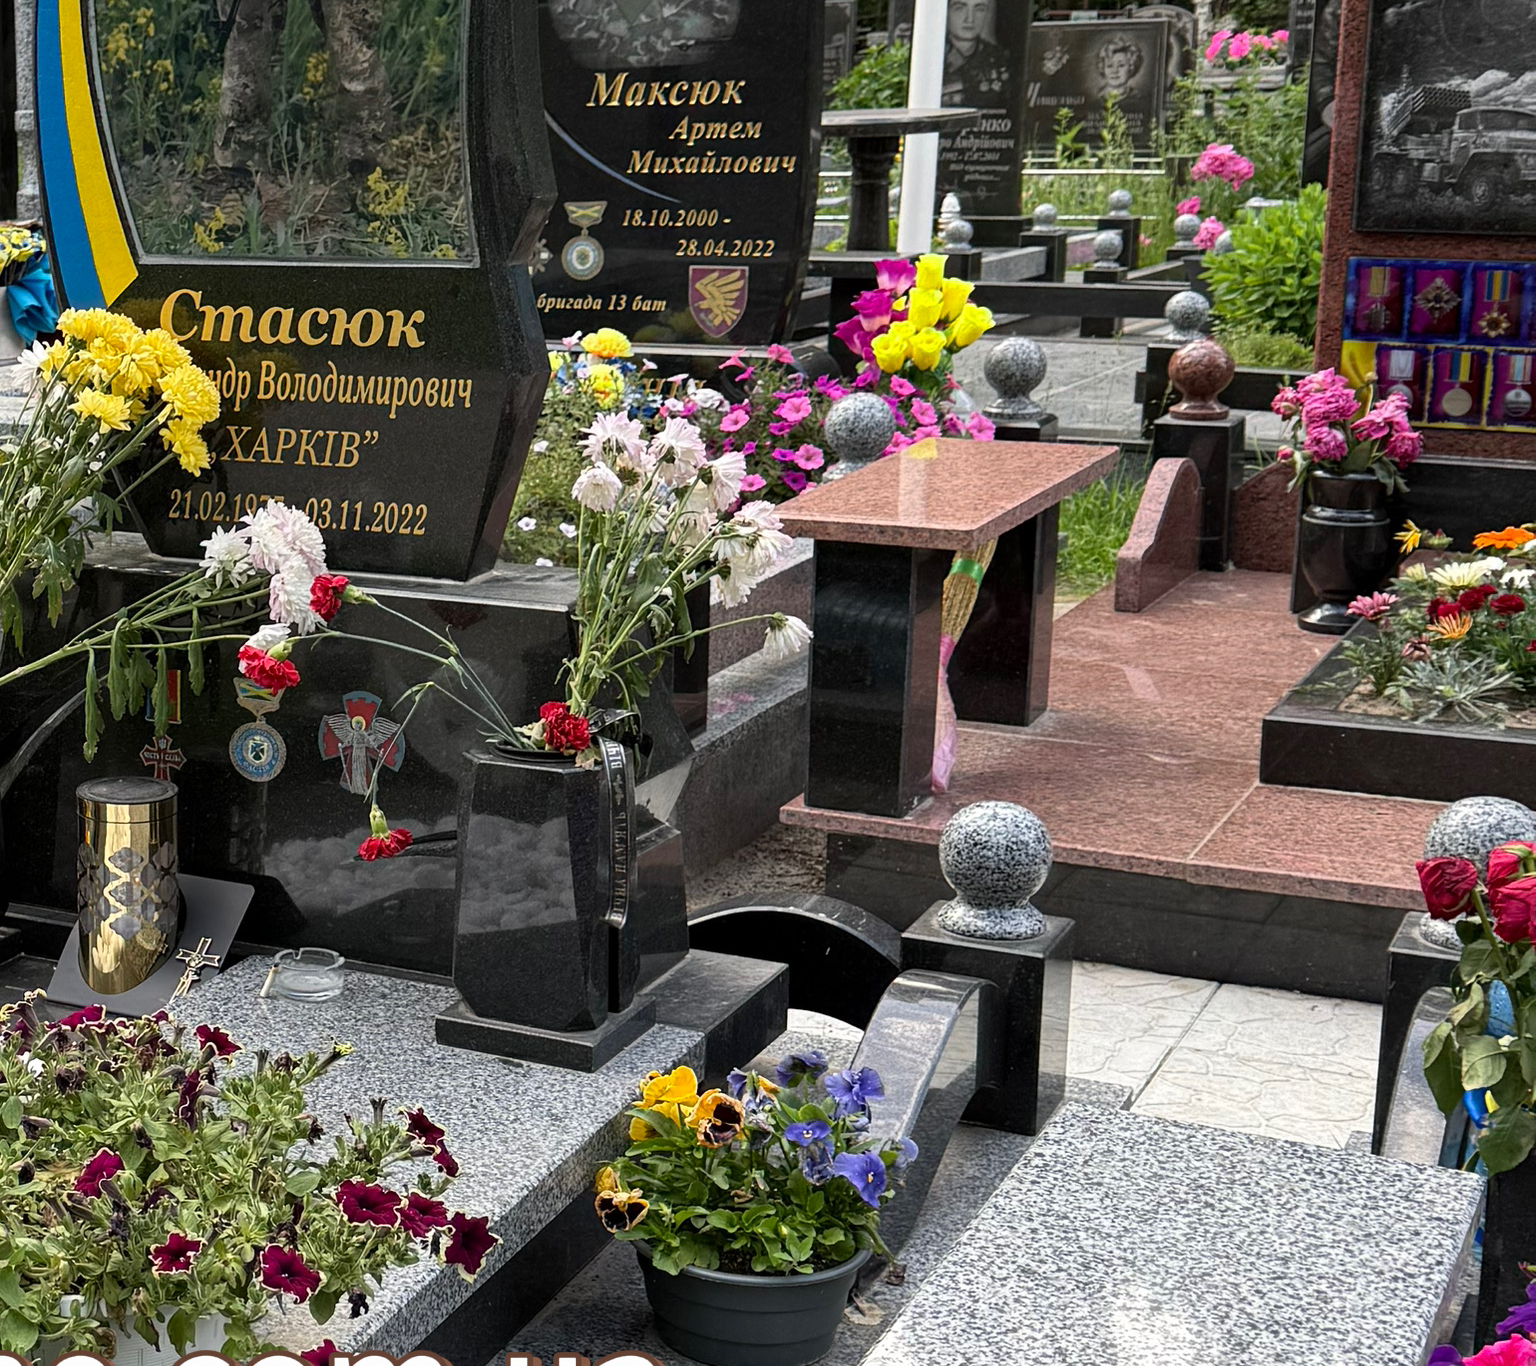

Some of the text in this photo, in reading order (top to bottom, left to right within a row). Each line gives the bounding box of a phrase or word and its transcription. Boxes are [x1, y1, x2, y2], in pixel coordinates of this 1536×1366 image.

[585, 71, 746, 108] Максюк
[668, 115, 763, 146] Артем
[625, 149, 798, 174] Михайлович
[621, 208, 719, 227] 18.10.2000
[675, 238, 776, 258] 28.04.2022
[536, 293, 668, 314] бригада 13 бат
[159, 288, 426, 349] Стасюк
[256, 359, 474, 420] Володимирович
